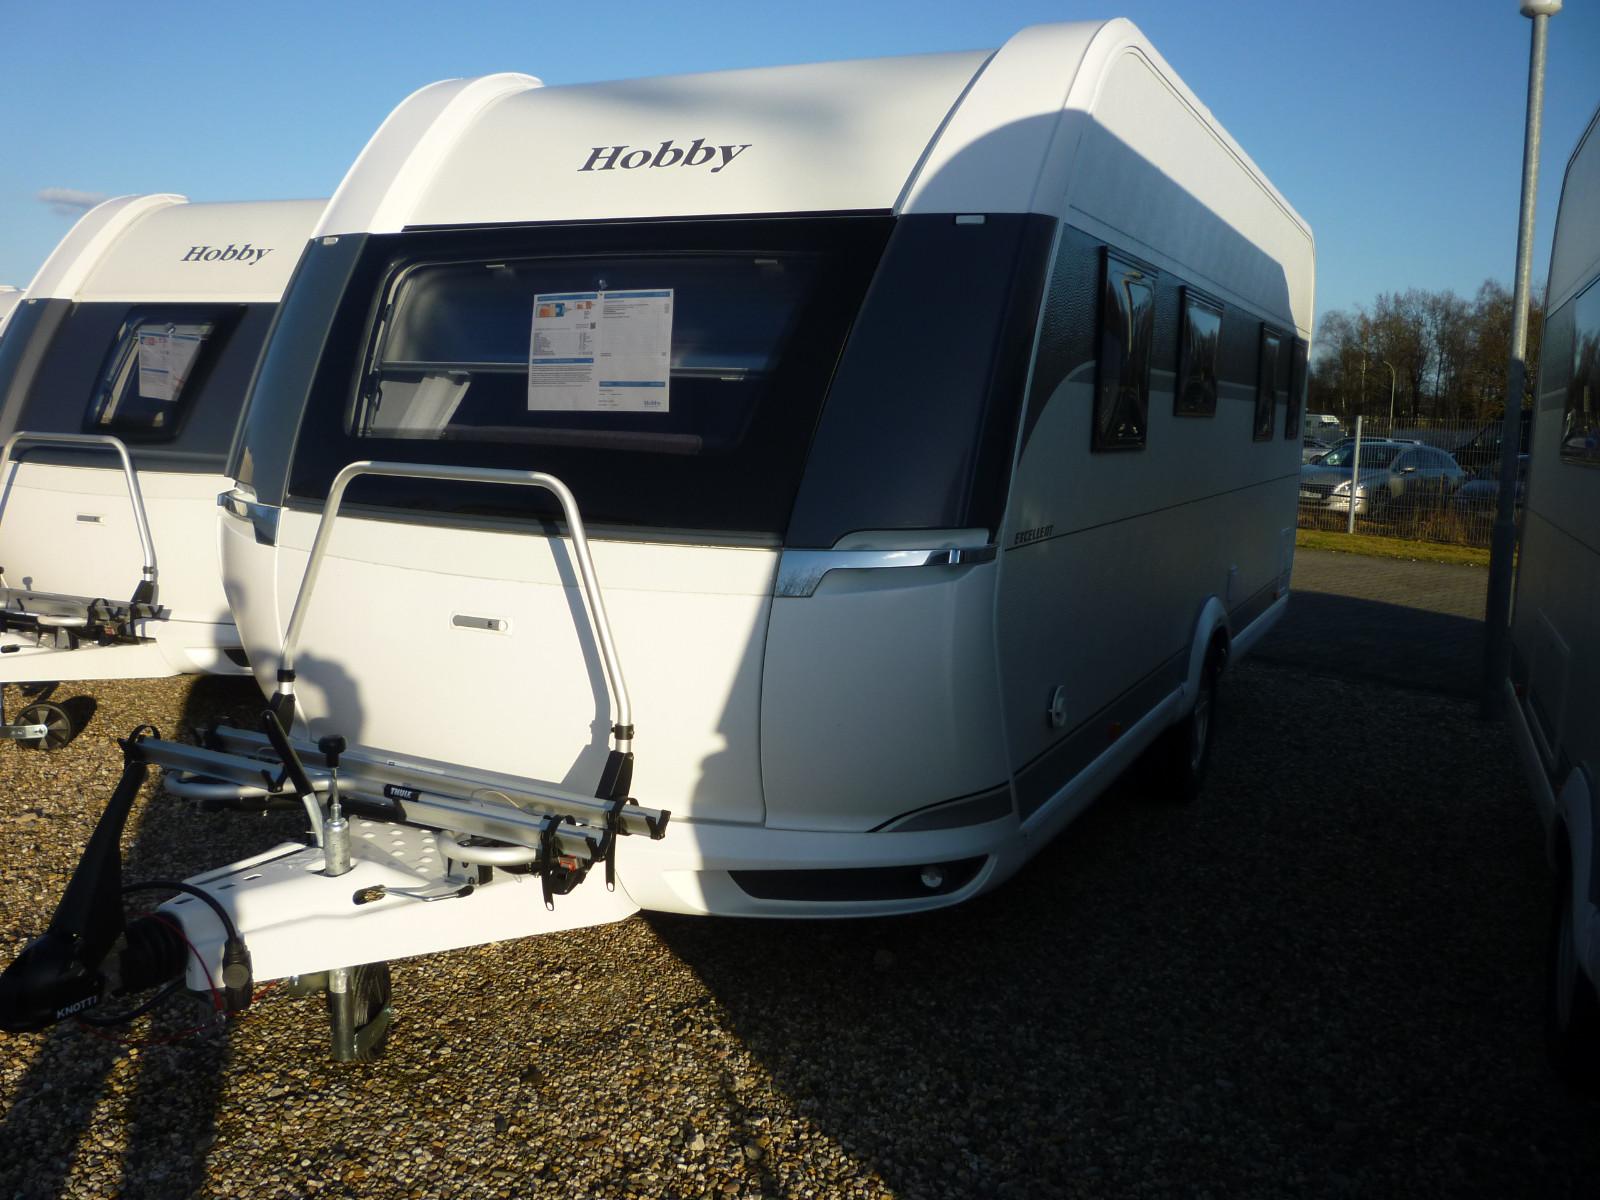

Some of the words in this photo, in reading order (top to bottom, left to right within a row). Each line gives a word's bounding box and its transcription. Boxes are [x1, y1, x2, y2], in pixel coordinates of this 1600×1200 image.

[577, 138, 752, 173] Hobby
[180, 244, 275, 265] Hobby
[390, 787, 412, 799] THULE
